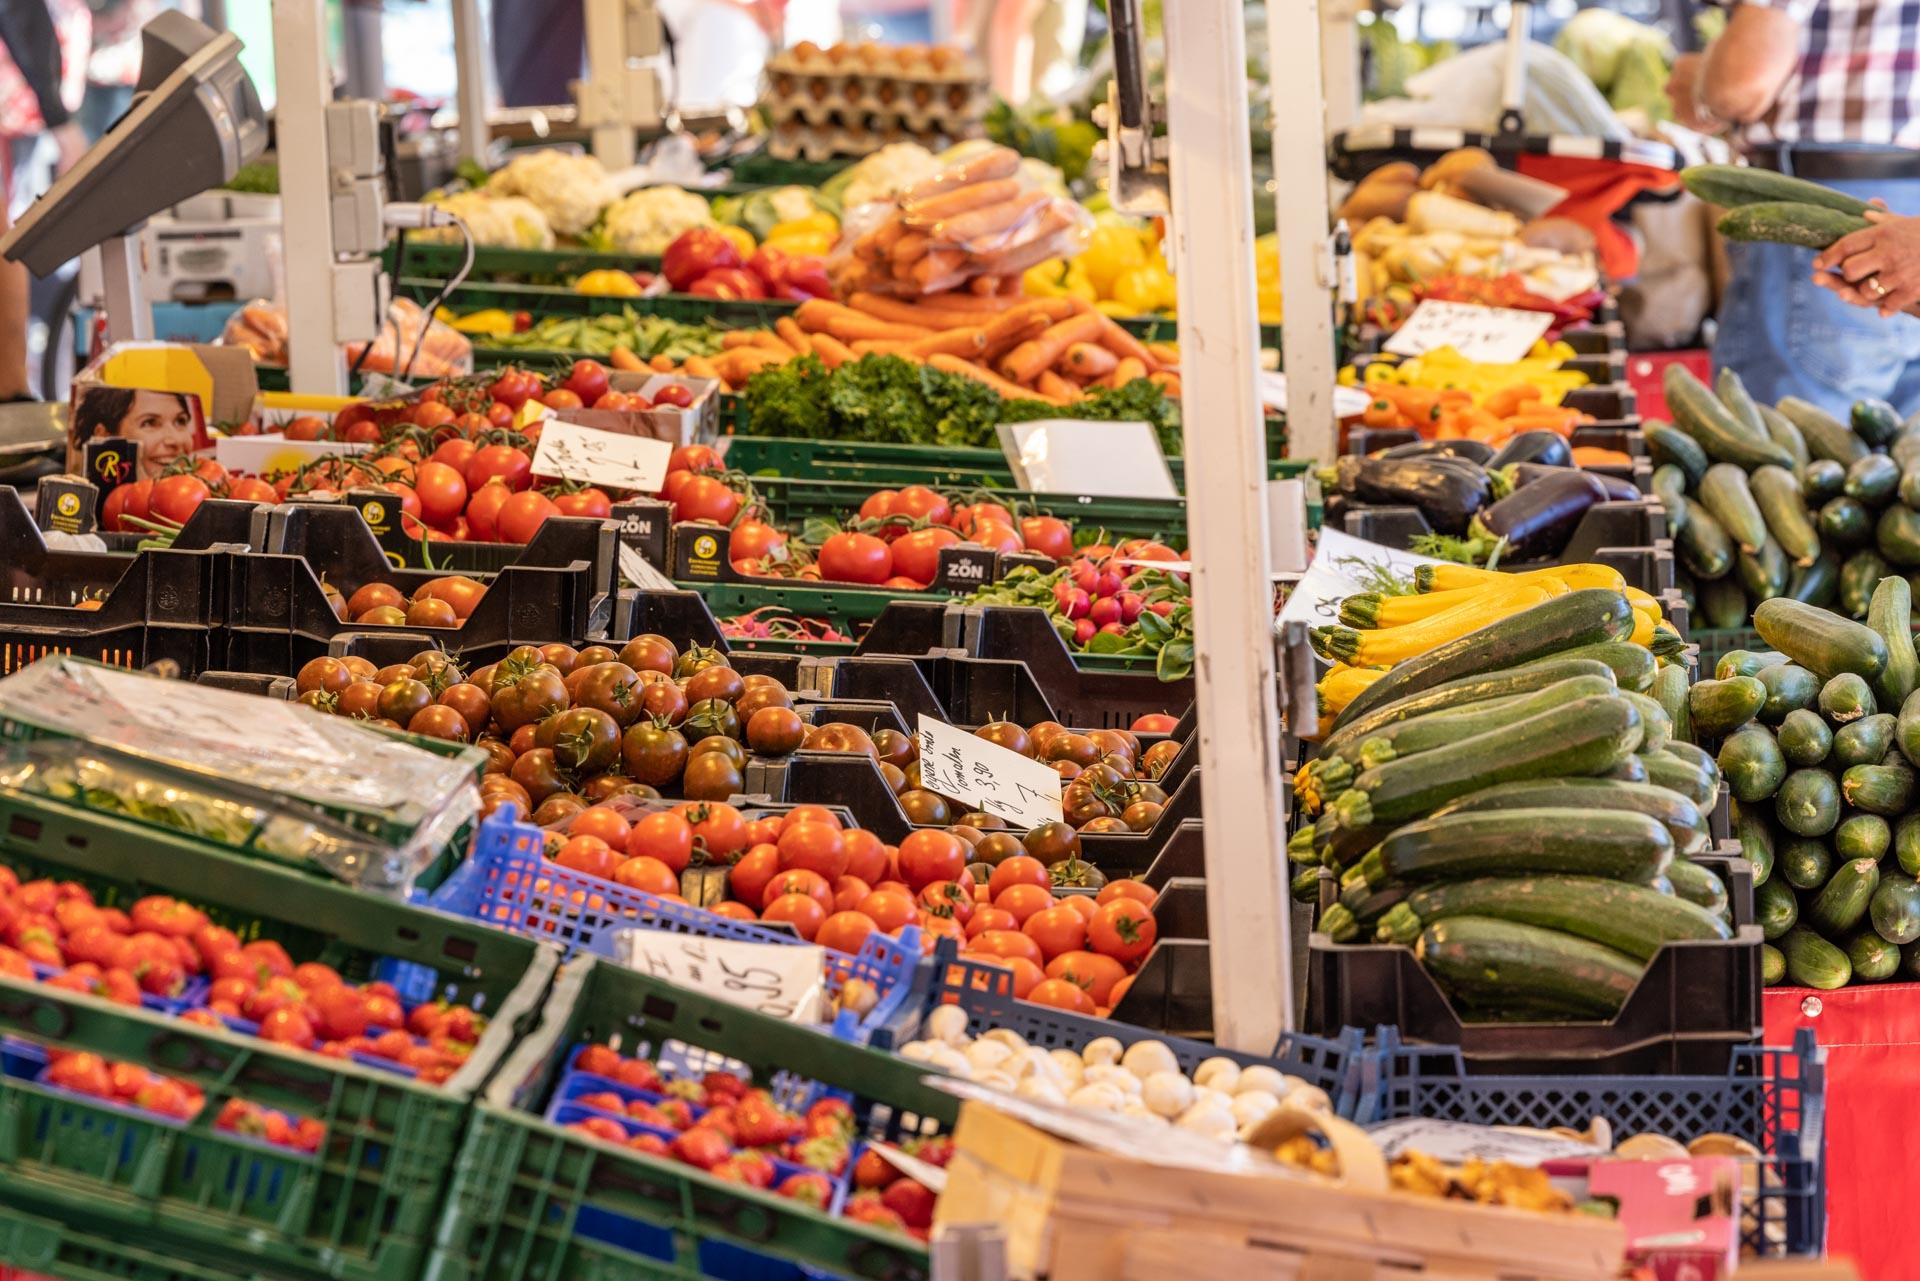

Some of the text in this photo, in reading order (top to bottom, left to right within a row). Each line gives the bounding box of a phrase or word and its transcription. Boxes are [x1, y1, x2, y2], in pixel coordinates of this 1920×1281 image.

[620, 520, 651, 535] ZON
[947, 563, 984, 579] ZON
[973, 761, 1000, 791] 3,90
